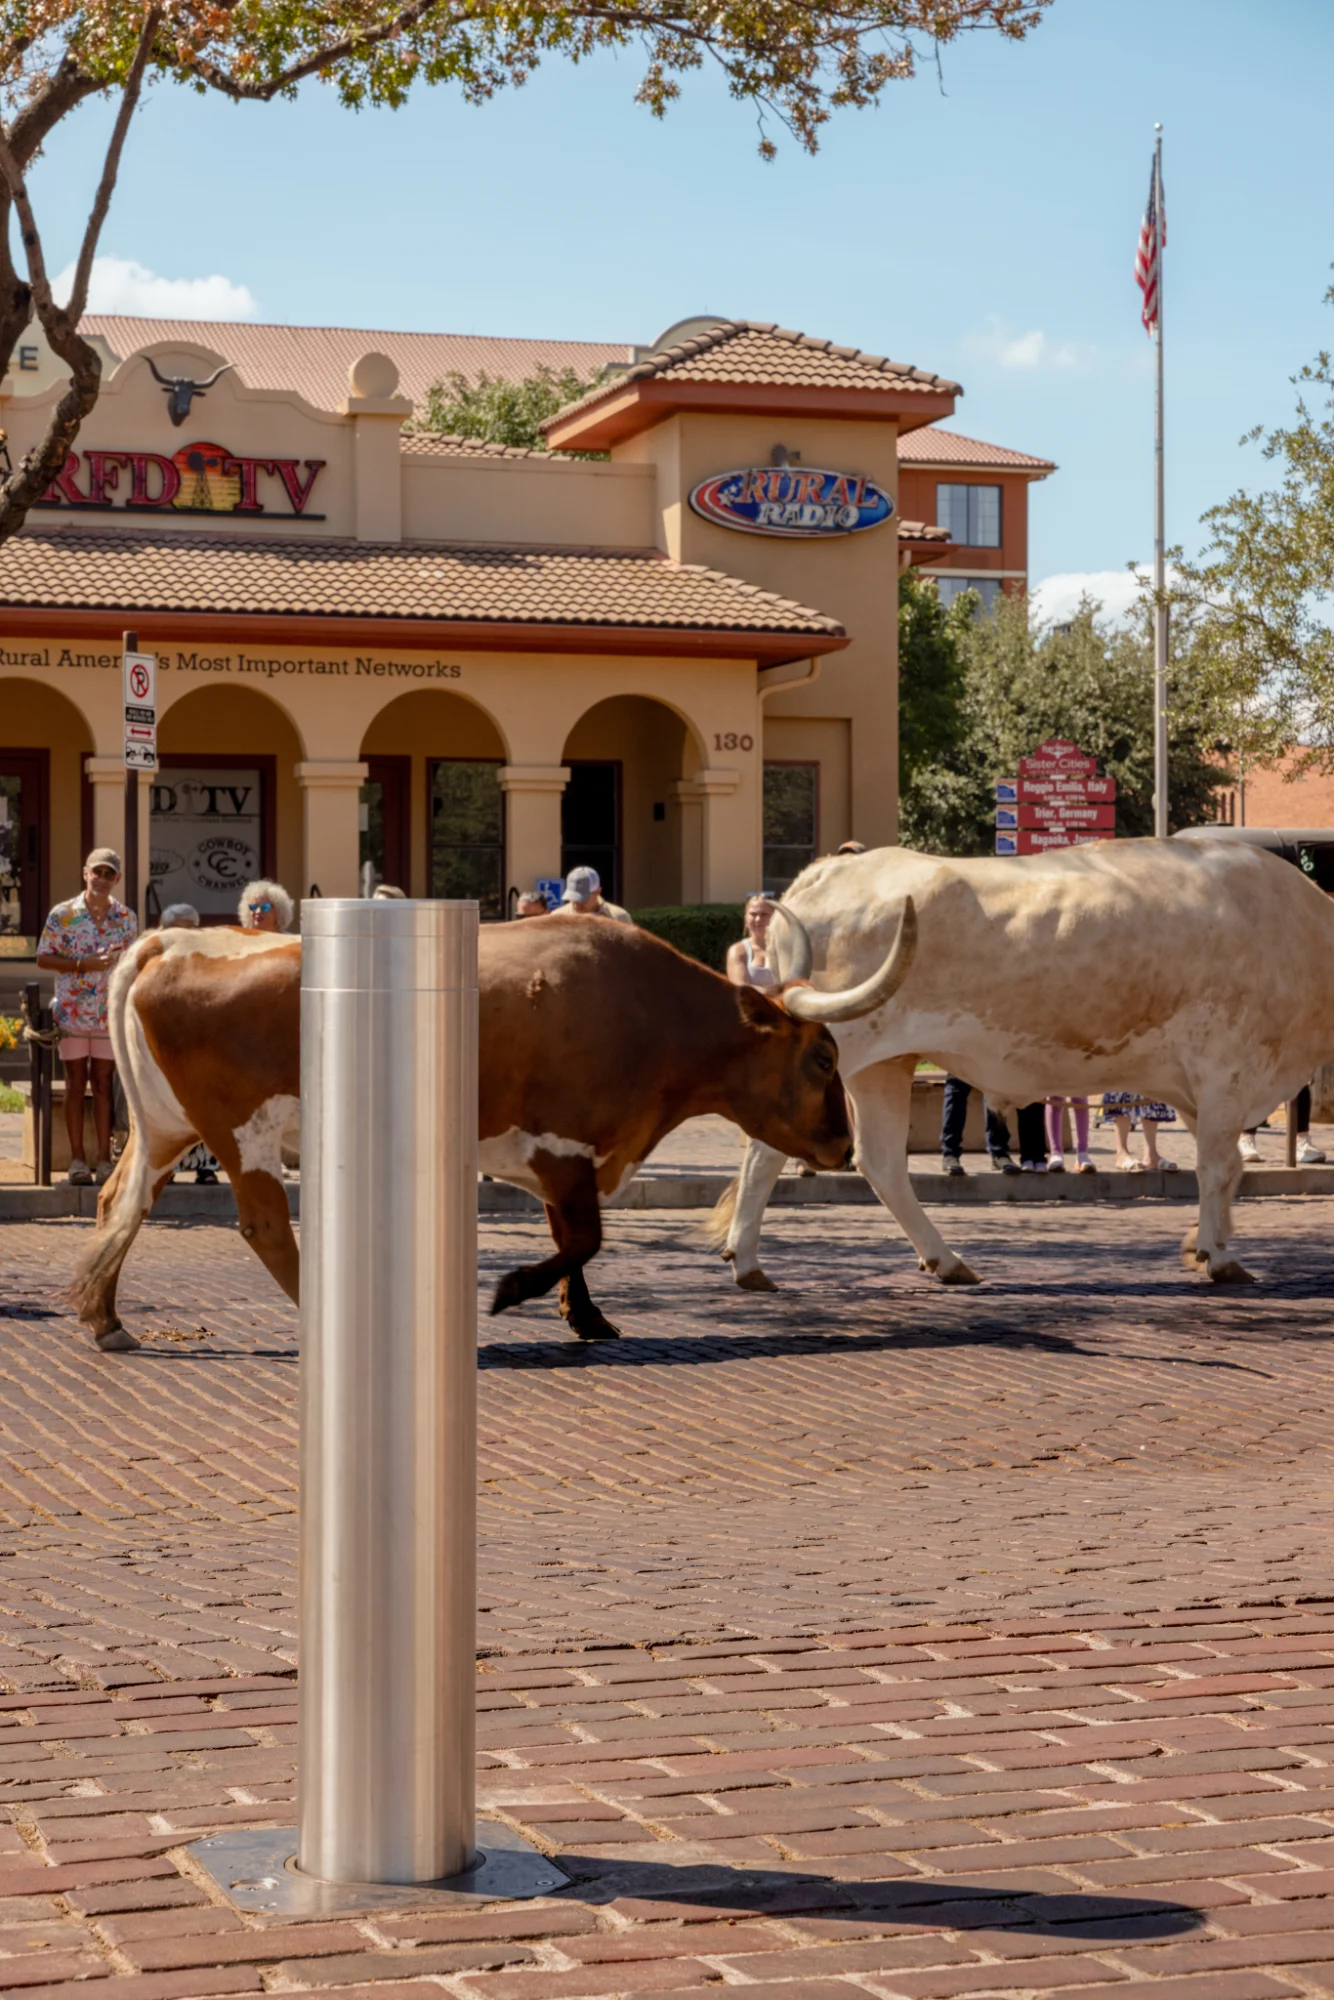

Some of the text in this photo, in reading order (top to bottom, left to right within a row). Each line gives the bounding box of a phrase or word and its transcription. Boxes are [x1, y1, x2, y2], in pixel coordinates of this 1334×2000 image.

[222, 456, 327, 514] TV
[734, 470, 880, 508] RURAL
[755, 502, 861, 528] RADIO
[57, 650, 170, 671] Amer's
[177, 653, 232, 672] Most
[237, 654, 349, 677] Important
[355, 657, 462, 678] Networks
[713, 732, 754, 752] 130
[1026, 758, 1090, 769] Sister Cities
[1023, 781, 1054, 794] Reggio
[1088, 781, 1107, 794] Italy
[199, 786, 253, 813] TV
[1059, 808, 1098, 821] Germany
[198, 838, 251, 856] COWBOY
